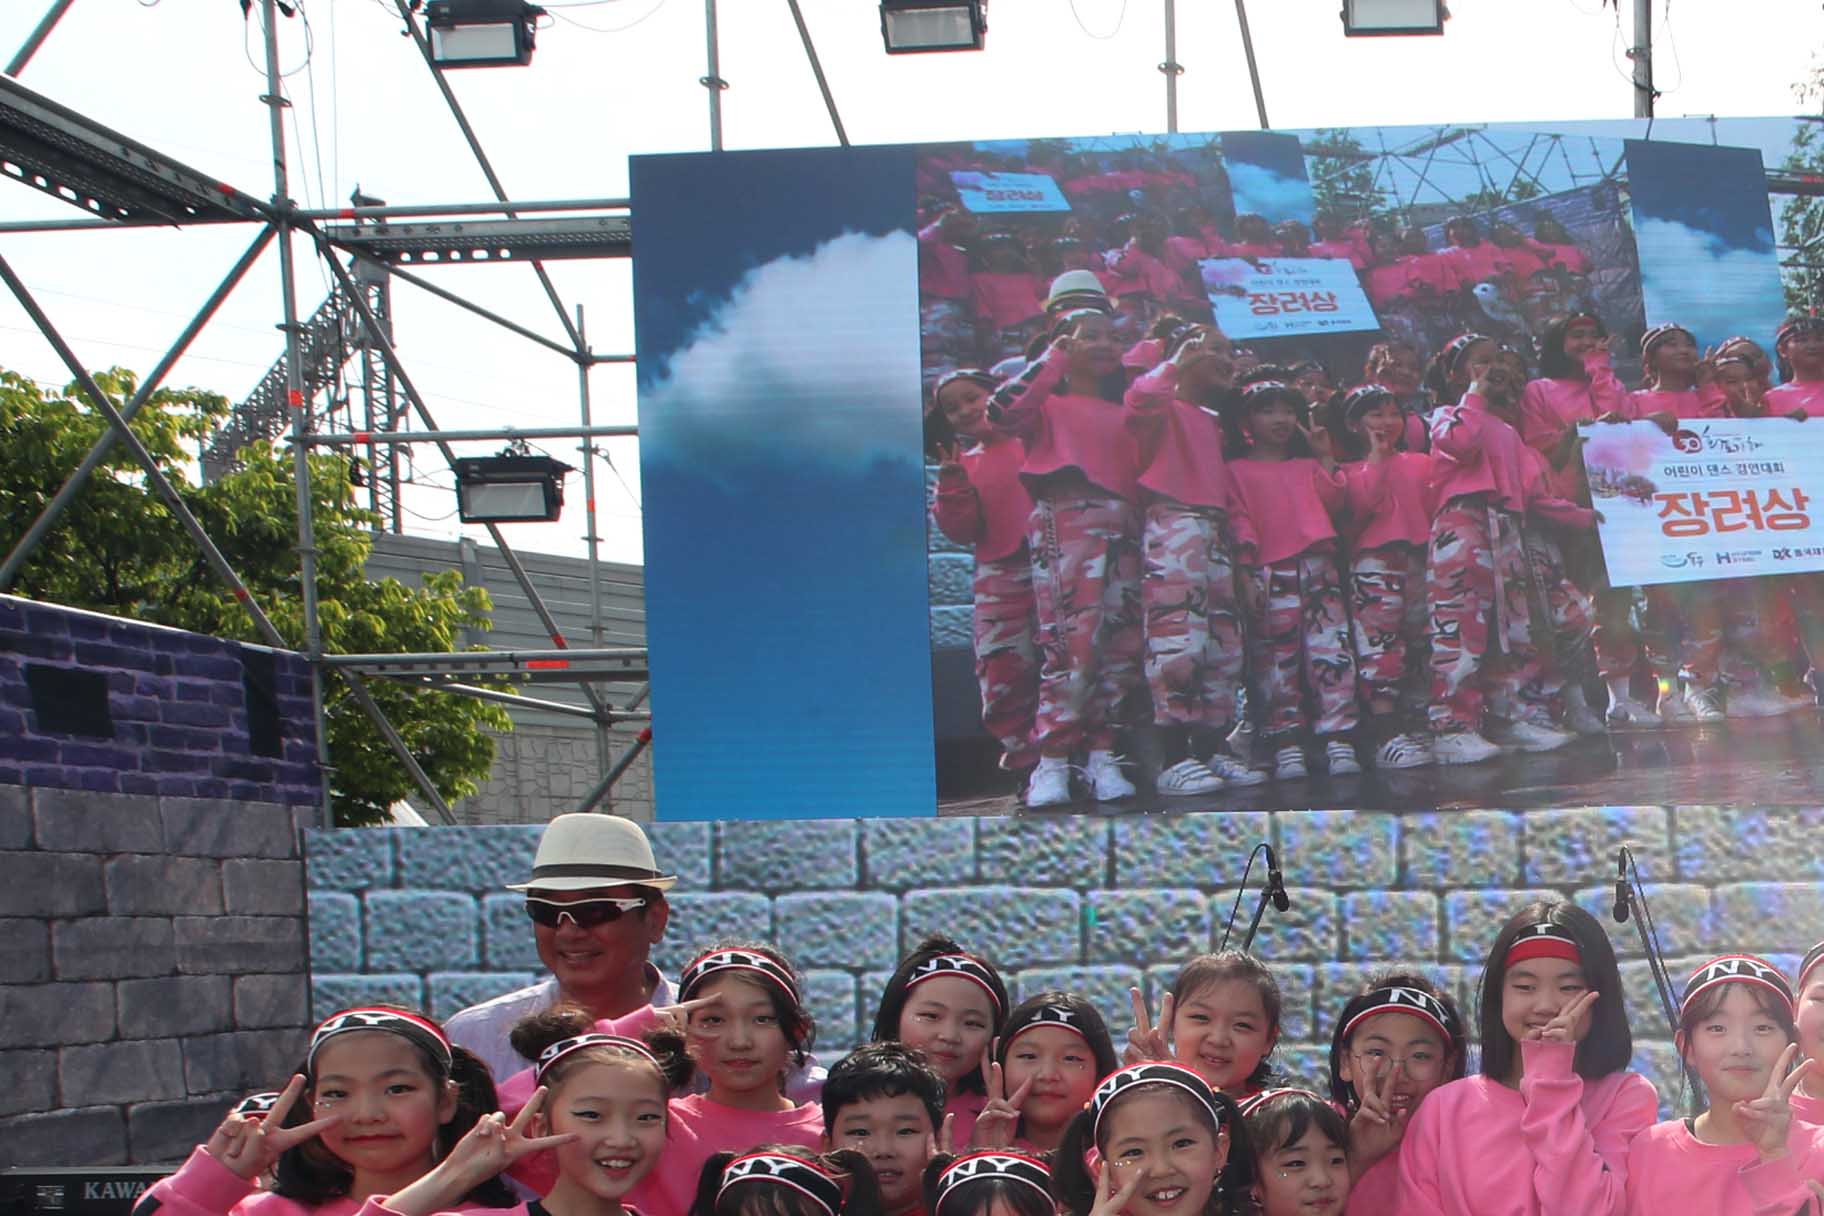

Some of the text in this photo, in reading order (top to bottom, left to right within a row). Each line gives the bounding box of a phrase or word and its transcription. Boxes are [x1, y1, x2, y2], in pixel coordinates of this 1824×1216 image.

[1654, 488, 1811, 537] 장려상
[696, 953, 768, 973] NY
[910, 957, 973, 980] NY
[1704, 960, 1770, 980] NY
[1389, 990, 1449, 1023] NY
[1094, 1065, 1153, 1110] NY
[720, 1159, 802, 1188] NY
[948, 1158, 1022, 1186] NY
[84, 1182, 155, 1199] KAWA
